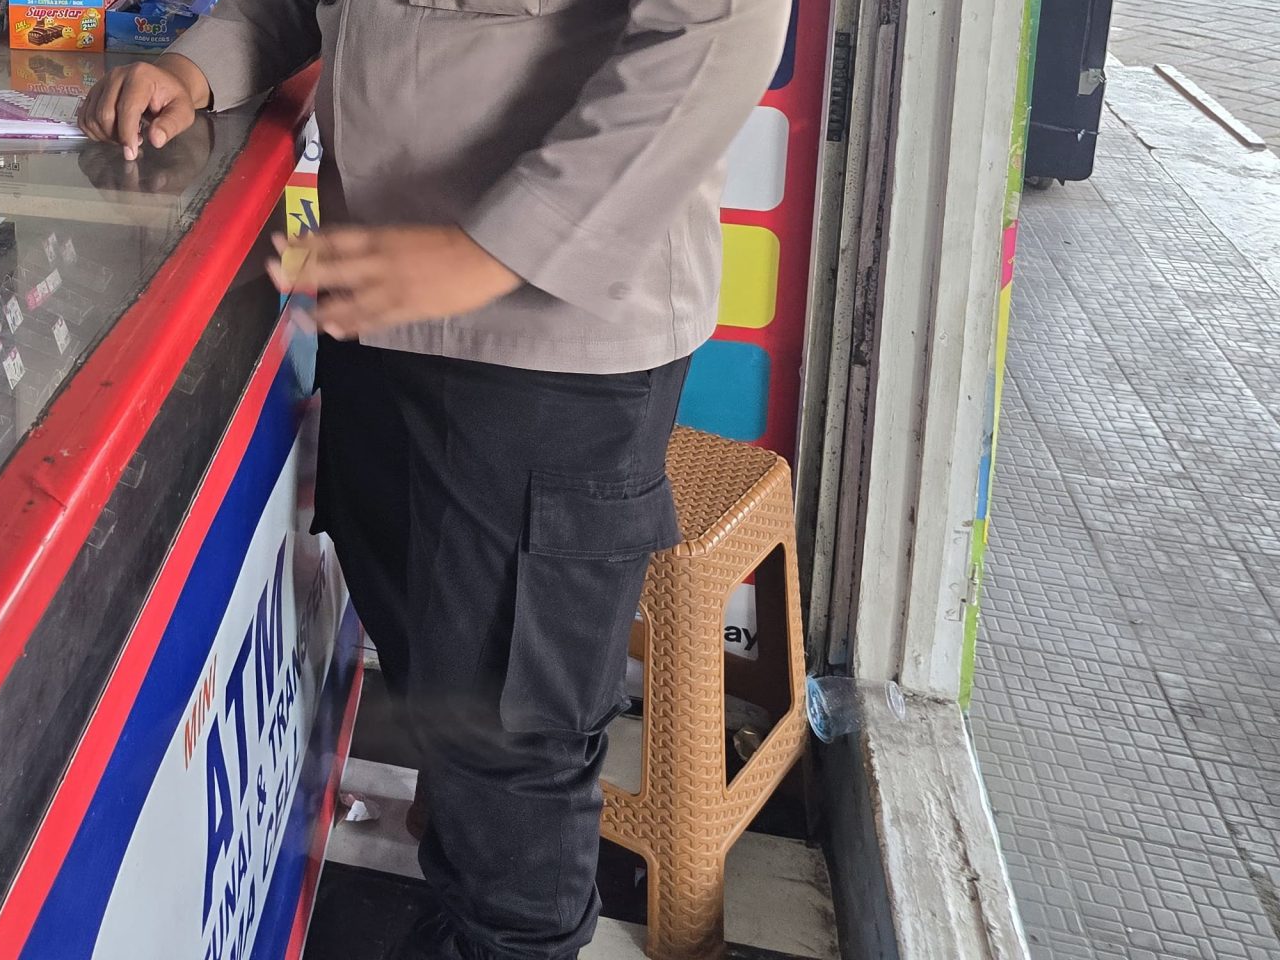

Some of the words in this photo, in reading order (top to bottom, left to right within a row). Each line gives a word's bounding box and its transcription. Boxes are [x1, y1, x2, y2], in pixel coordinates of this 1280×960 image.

[26, 6, 83, 20] Superstar
[135, 17, 168, 34] Yupi
[183, 654, 217, 771] MINI
[202, 530, 288, 937] ATM
